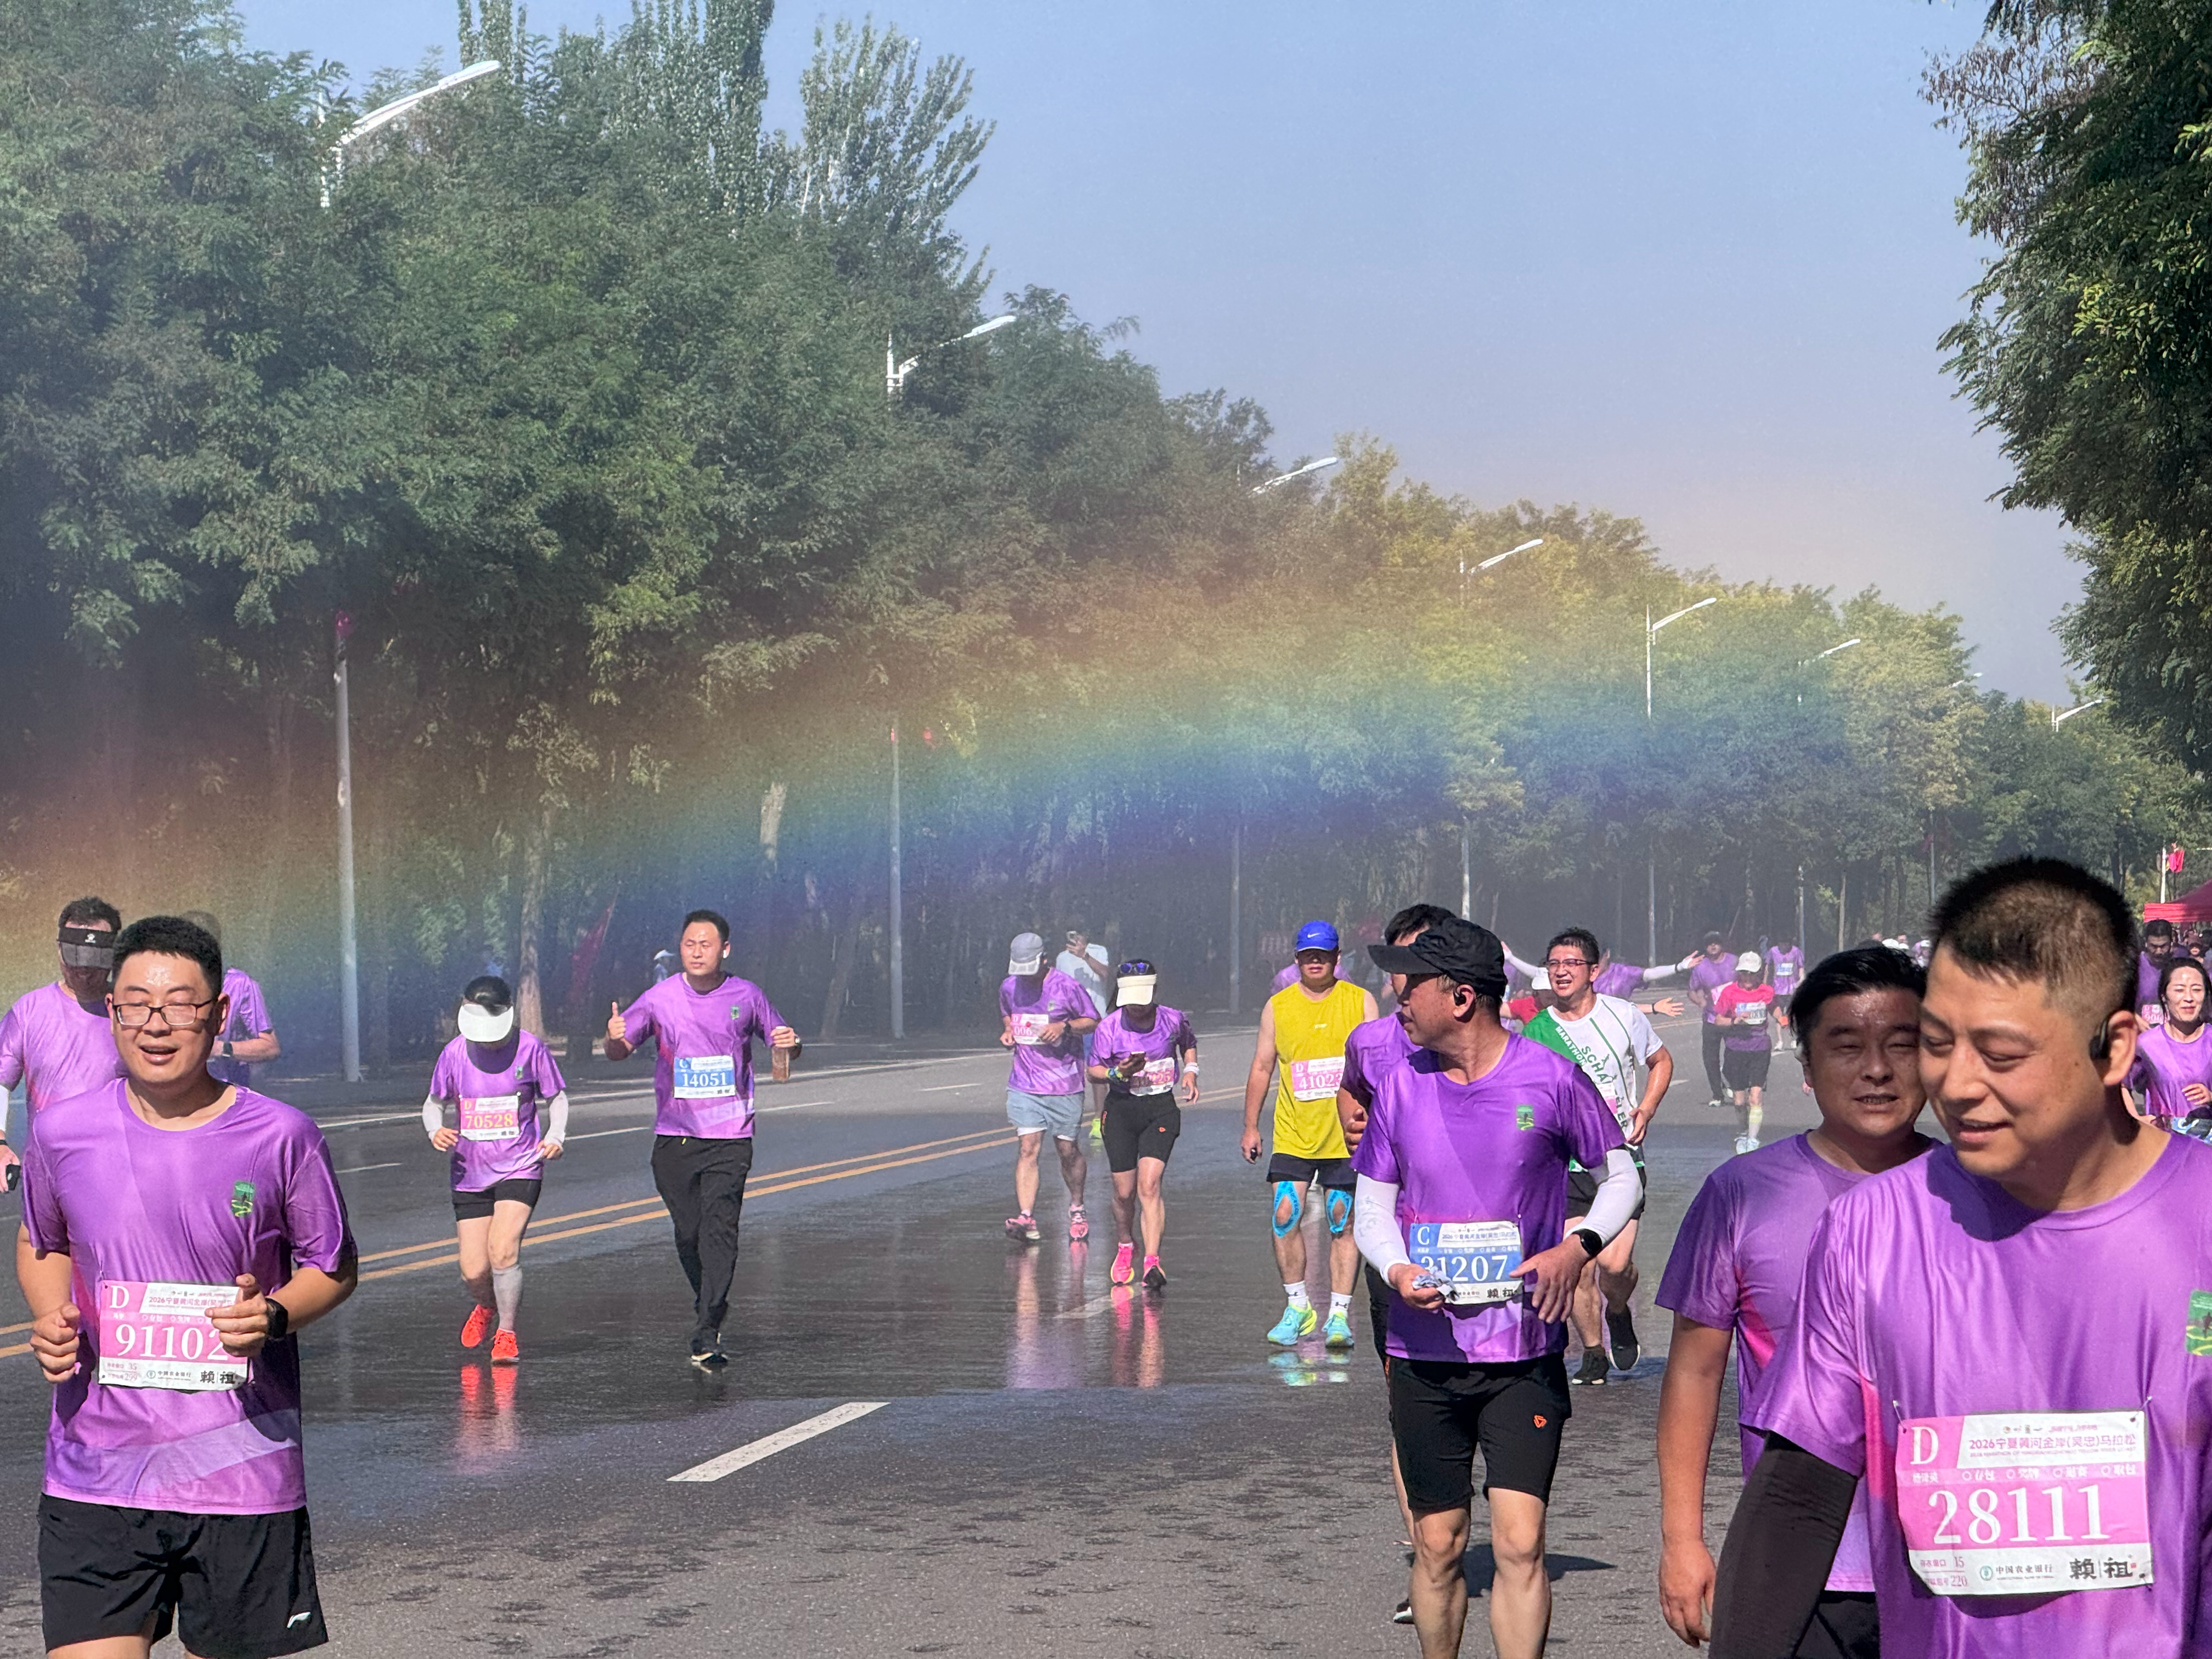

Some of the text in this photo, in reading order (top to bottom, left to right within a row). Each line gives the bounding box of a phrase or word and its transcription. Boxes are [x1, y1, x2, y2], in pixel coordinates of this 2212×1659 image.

[1555, 1026, 1587, 1066] MARATHON
[1296, 1063, 1304, 1073] D
[682, 1072, 727, 1087] 14051
[464, 1101, 471, 1110] D
[465, 1113, 513, 1128] 70528
[1417, 1226, 1430, 1245] C
[110, 1285, 129, 1308] D
[115, 1324, 228, 1361] 91102
[1909, 1426, 1939, 1465] D
[1928, 1484, 2111, 1544] 28111
[1954, 1556, 1965, 1568] 15
[1996, 1564, 2053, 1575] 中国农业银行
[1950, 1575, 1967, 1587] 220
